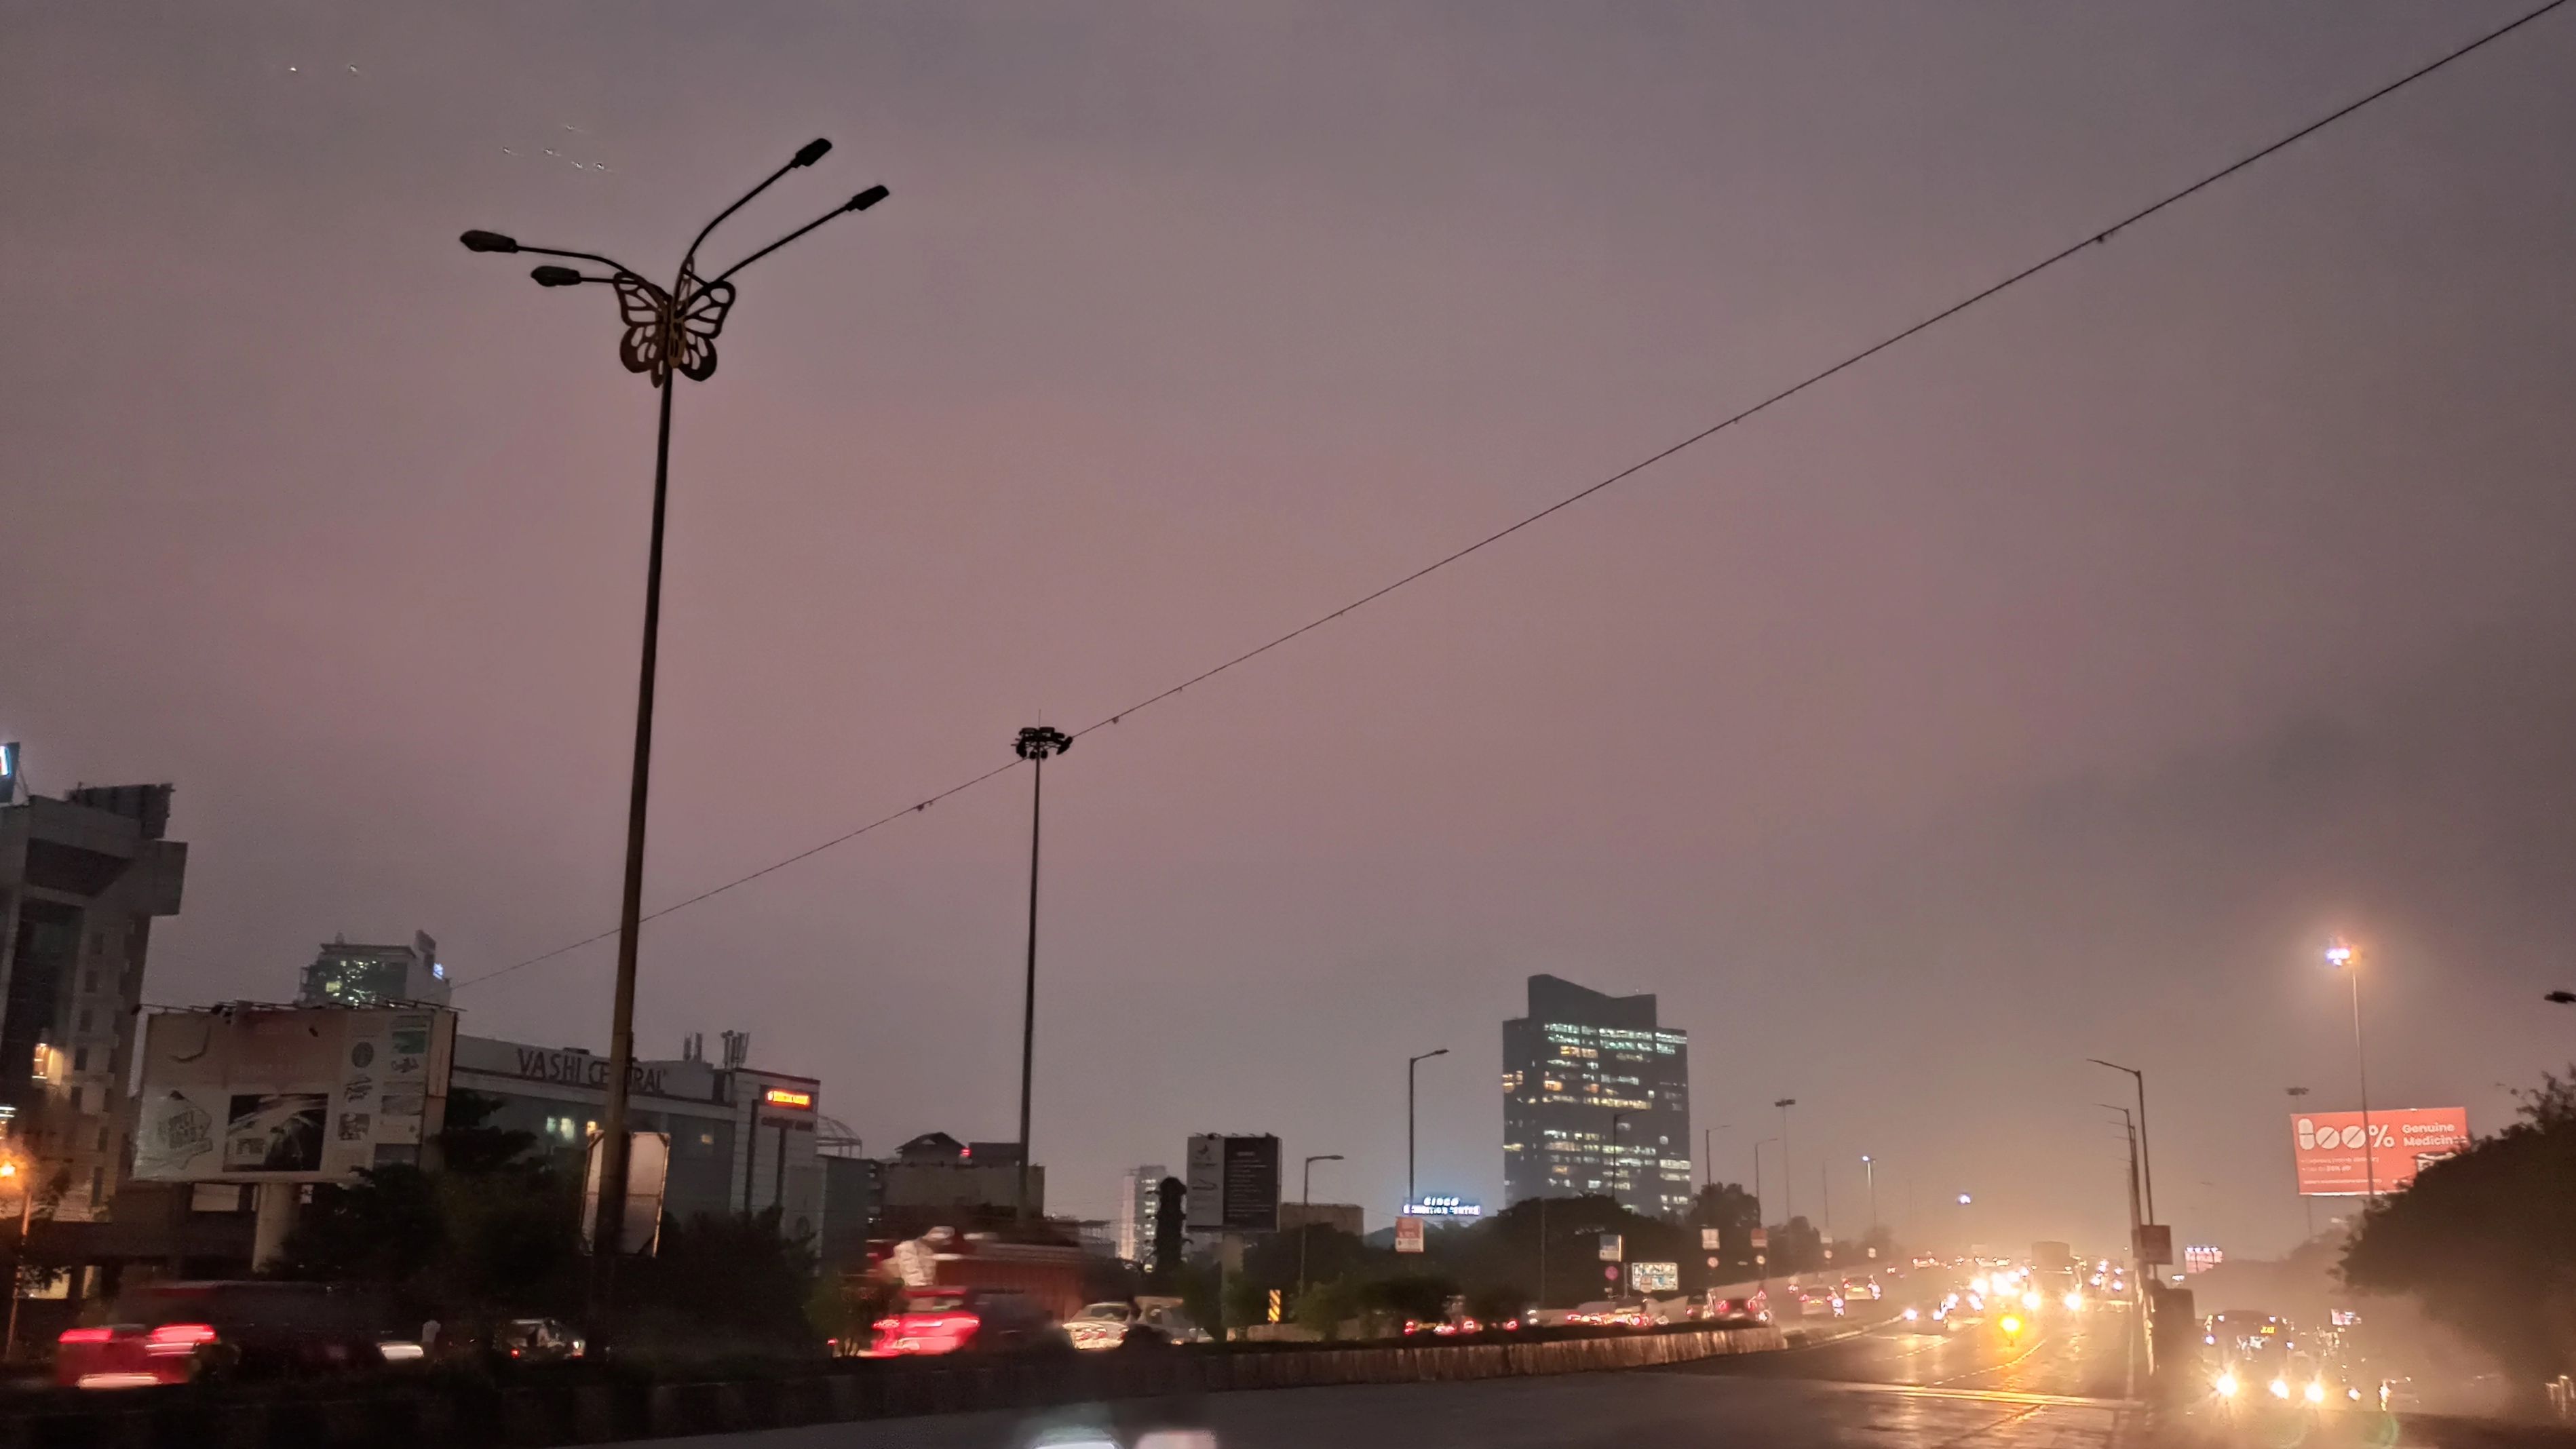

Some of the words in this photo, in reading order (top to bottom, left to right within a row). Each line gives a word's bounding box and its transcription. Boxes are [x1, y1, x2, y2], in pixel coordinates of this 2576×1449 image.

[518, 1048, 582, 1083] VASHI
[588, 1060, 665, 1093] CERAL
[2402, 1122, 2455, 1134] Genuine
